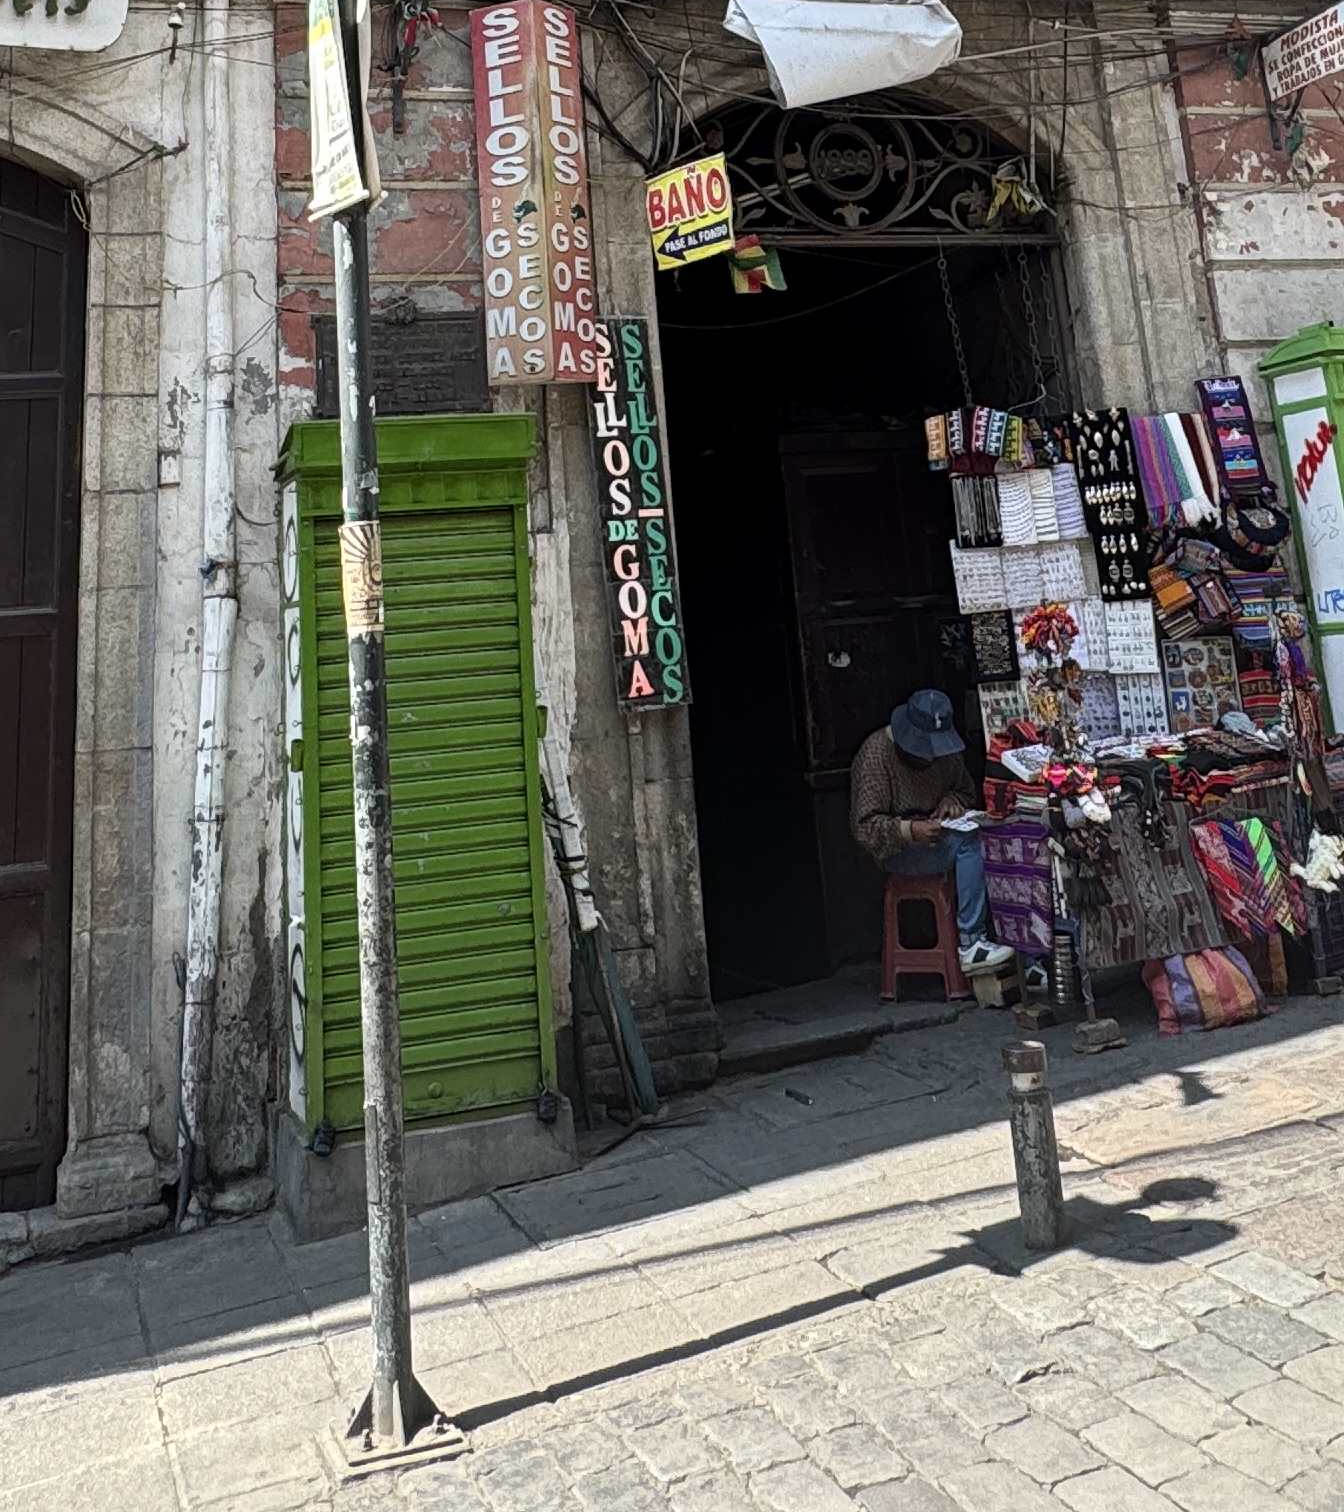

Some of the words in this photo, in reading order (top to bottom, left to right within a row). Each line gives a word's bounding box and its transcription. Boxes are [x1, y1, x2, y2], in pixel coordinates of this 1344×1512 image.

[482, 7, 530, 187] SELLOS
[543, 7, 580, 185] SELLOS
[1277, 62, 1302, 83] ROPA
[1304, 53, 1316, 68] DE
[1280, 9, 1338, 52] MODISTA
[1280, 64, 1321, 94] TRABAJOS
[491, 196, 502, 224] DE
[648, 165, 727, 229] BAÑO
[665, 239, 686, 254] PASE
[699, 224, 728, 243] FONDO
[486, 227, 518, 379] GOMA
[517, 223, 546, 374] SECOS
[551, 222, 577, 372] GOMA
[573, 226, 596, 374] SECOS
[593, 323, 630, 516] SELLOS
[608, 519, 638, 542] DE
[620, 324, 661, 507] SELLOS
[645, 519, 684, 705] SECOS
[613, 544, 655, 699] GOMA
